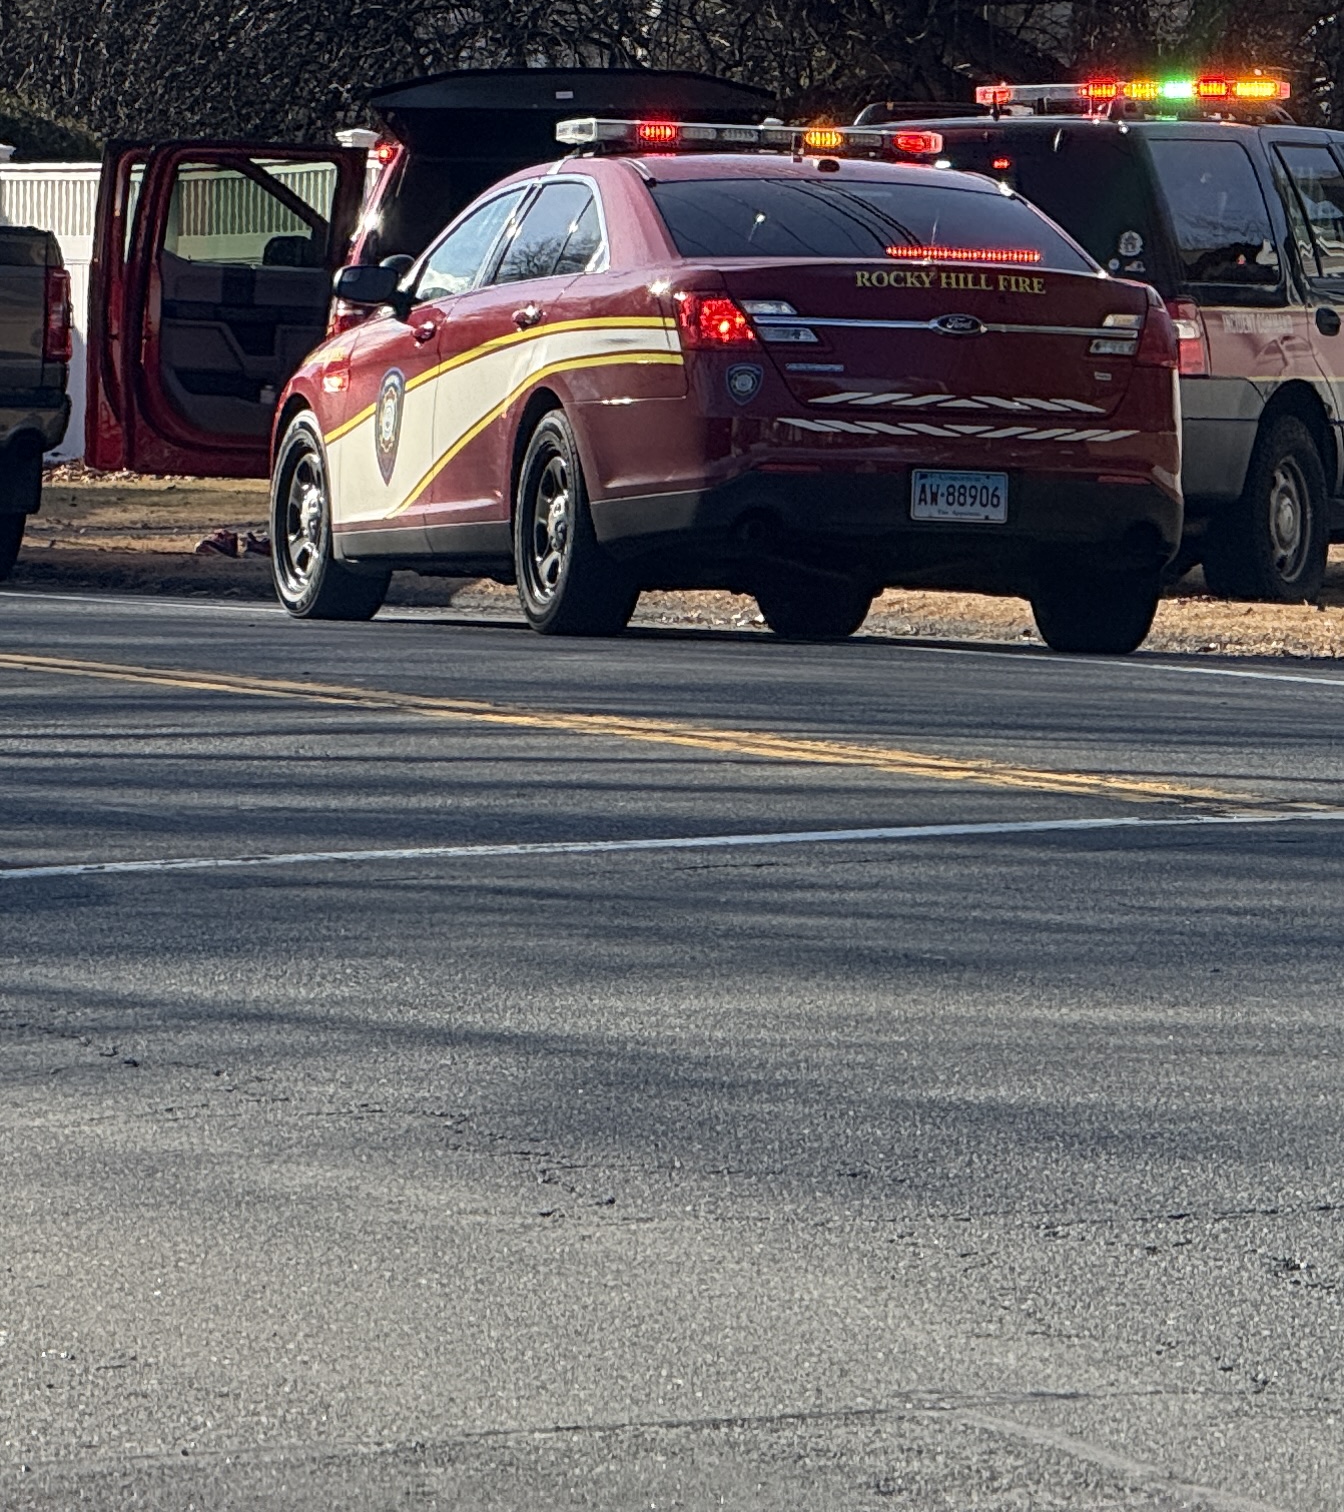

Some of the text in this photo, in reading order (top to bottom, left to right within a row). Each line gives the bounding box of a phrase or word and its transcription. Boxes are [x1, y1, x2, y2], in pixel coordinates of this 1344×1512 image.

[856, 270, 1046, 294] ROCKY HILL FIRE
